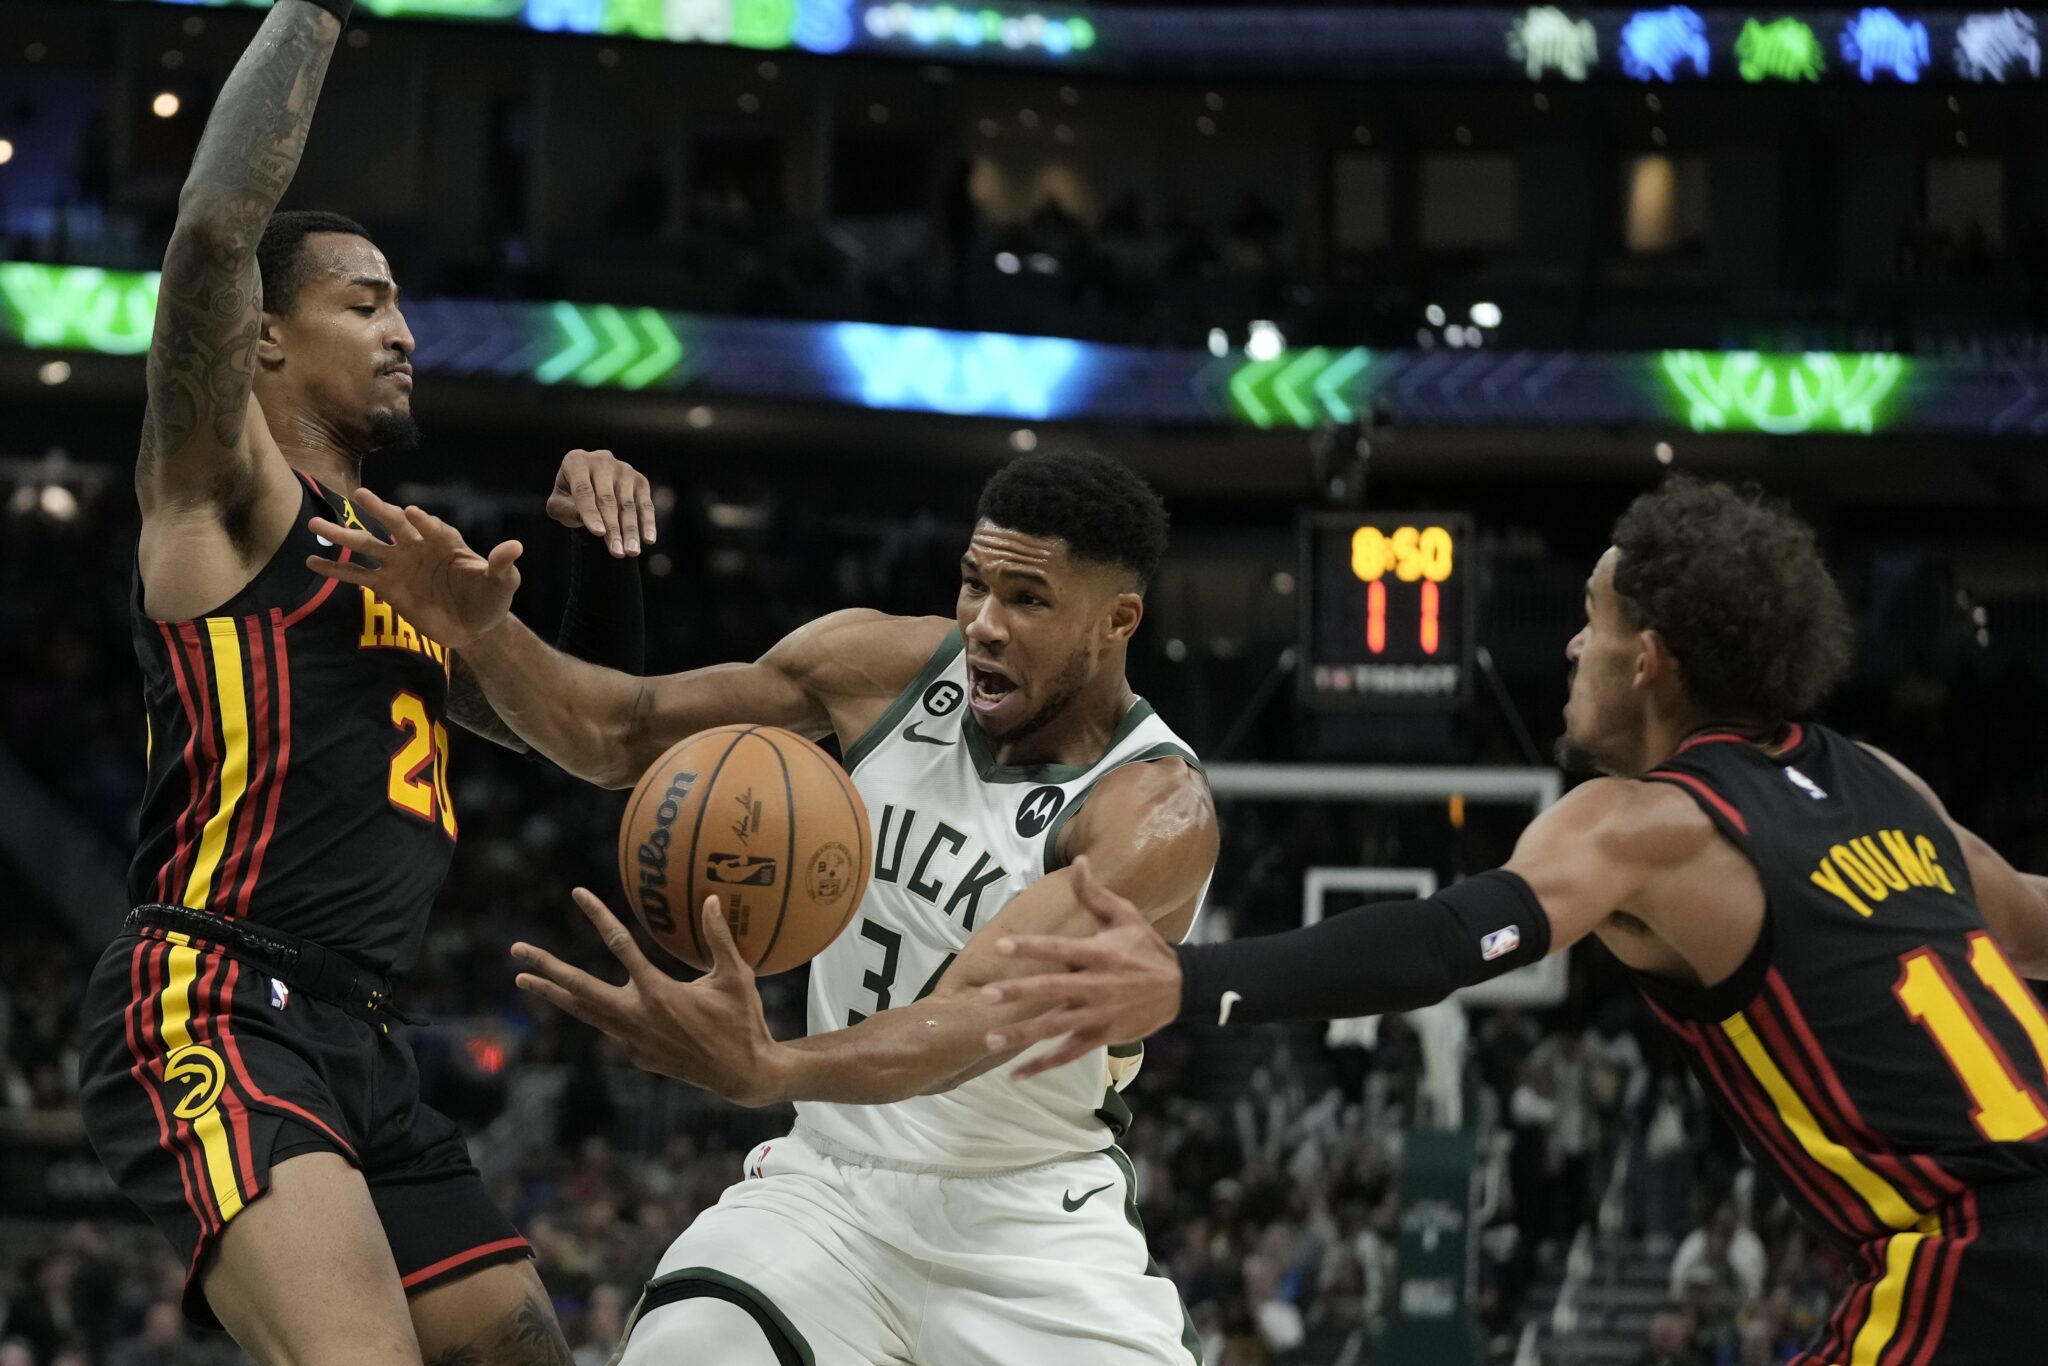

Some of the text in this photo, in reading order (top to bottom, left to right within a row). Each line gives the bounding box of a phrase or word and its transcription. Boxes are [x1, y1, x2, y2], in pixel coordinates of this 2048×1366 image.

[1367, 579, 1439, 655] 11
[928, 684, 960, 714] 6
[387, 688, 458, 843] 20
[874, 804, 1009, 933] UCK
[1810, 829, 1957, 918] YOUNG
[1891, 929, 2048, 1143] 11
